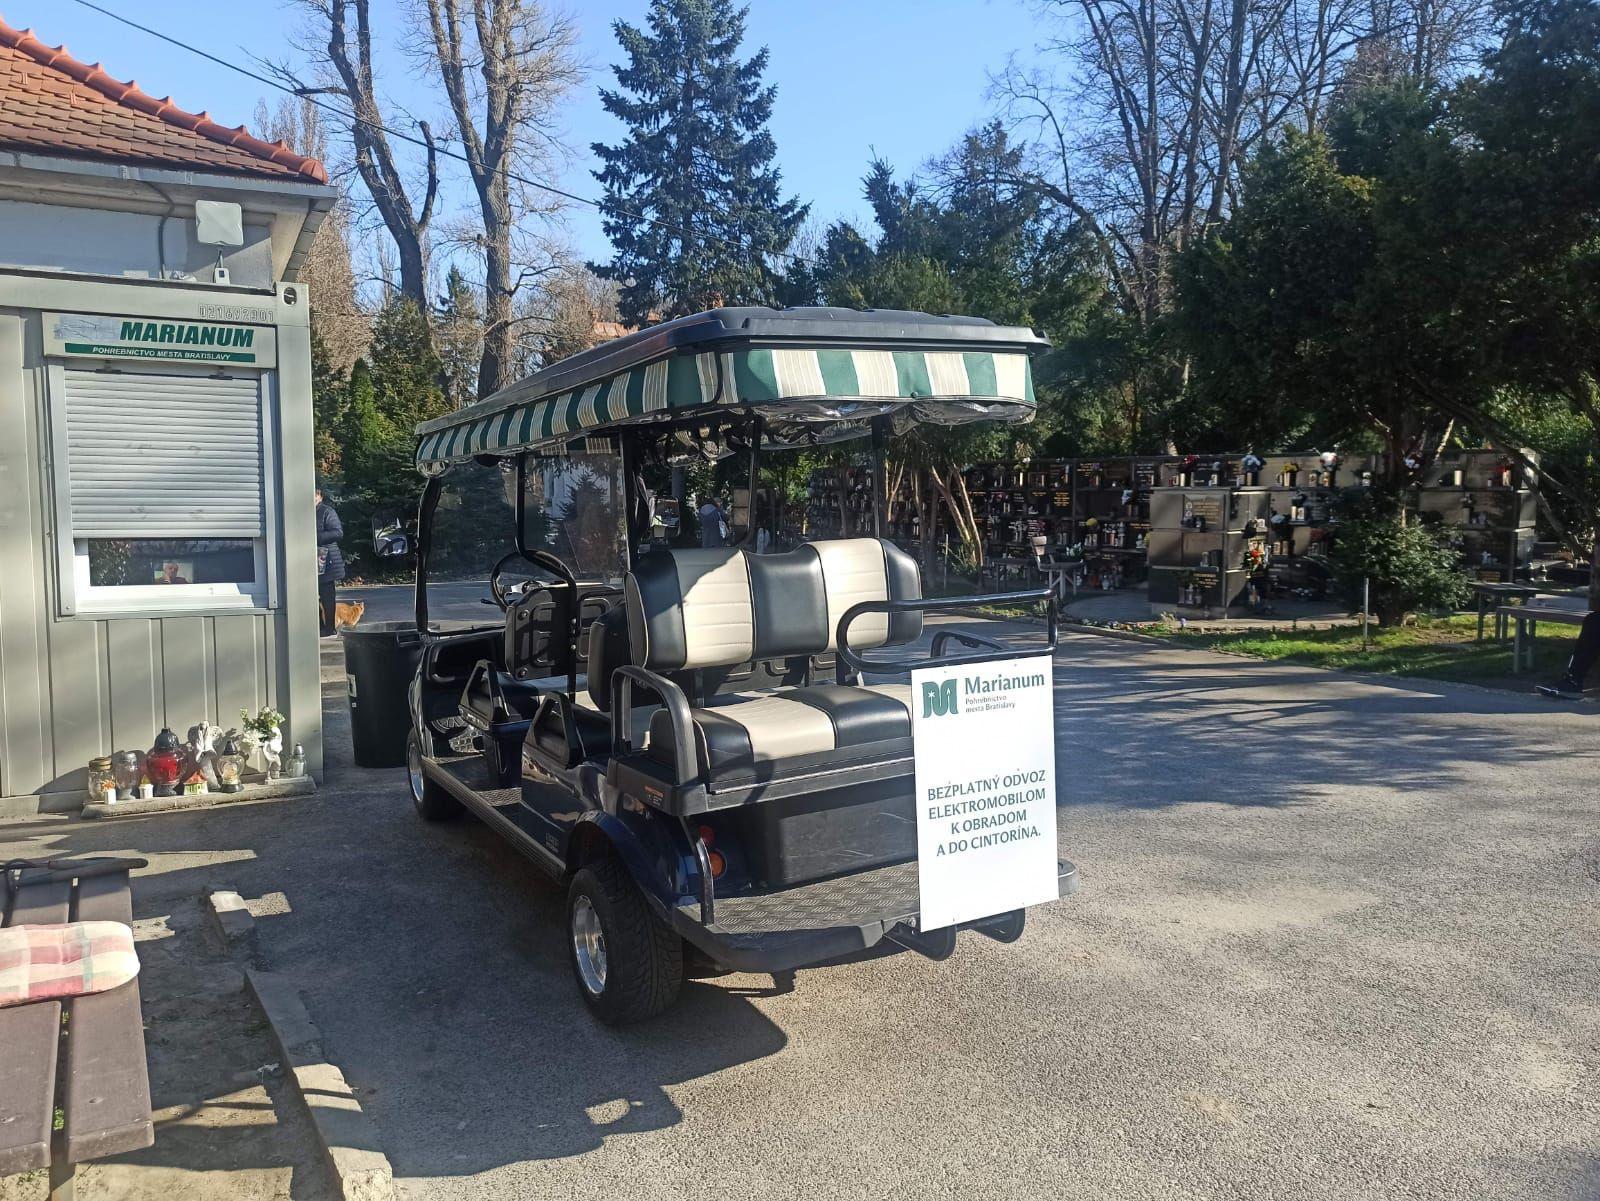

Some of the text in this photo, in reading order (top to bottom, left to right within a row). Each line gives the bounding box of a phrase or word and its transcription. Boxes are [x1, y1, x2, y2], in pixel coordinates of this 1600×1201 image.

[120, 321, 255, 347] MARIANUM
[156, 350, 183, 359] MESTA
[184, 352, 231, 361] BRATISLAVY
[964, 673, 1045, 695] Marianum
[965, 701, 1016, 713] mesta Bratislavy
[1003, 769, 1046, 788] ODVOZ
[928, 787, 1046, 820] ELEKTROMOBILOM
[951, 809, 1027, 835] K OBRADOM
[936, 844, 946, 857] A
[948, 839, 968, 854] DO
